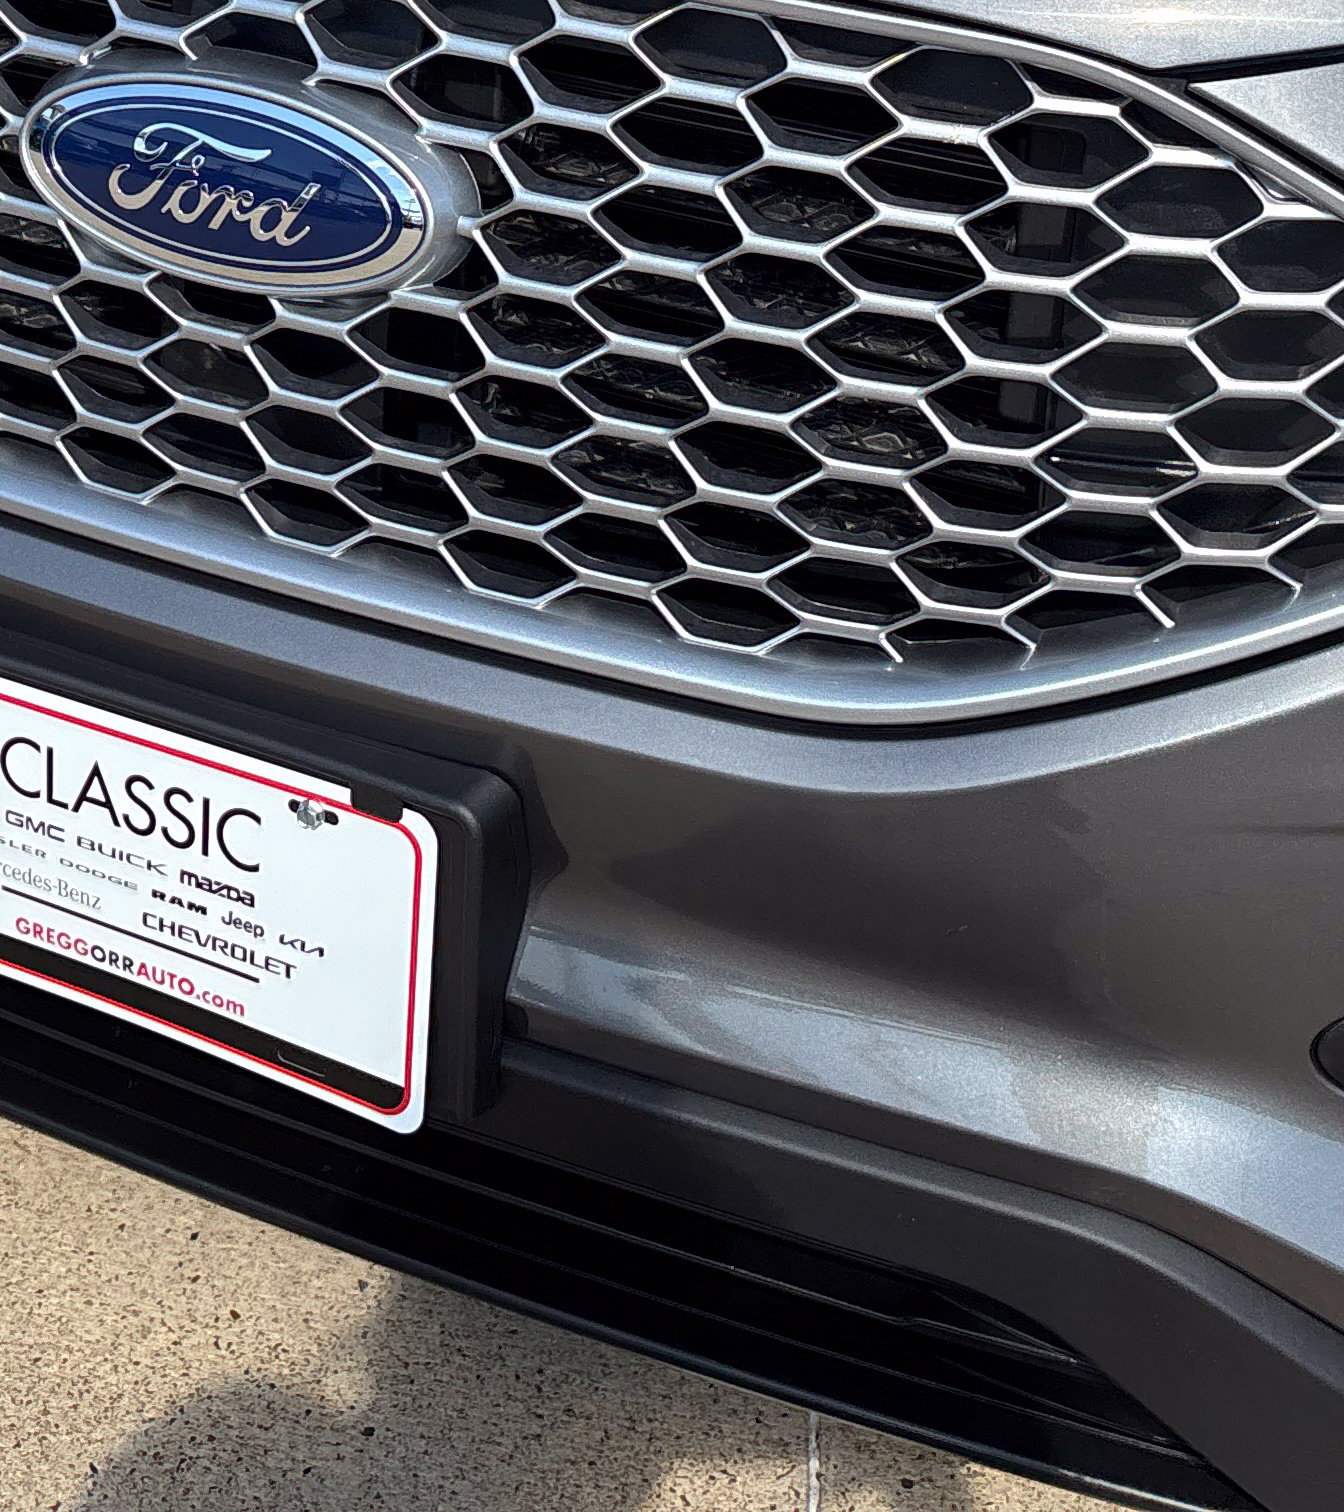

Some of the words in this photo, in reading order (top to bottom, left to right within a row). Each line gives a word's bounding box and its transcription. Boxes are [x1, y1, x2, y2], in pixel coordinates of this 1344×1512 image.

[108, 122, 322, 247] Ford
[0, 736, 260, 872] CLASSIC
[5, 809, 66, 843] GMC
[76, 836, 168, 877] BUICK
[59, 858, 138, 891] DODGE
[151, 889, 208, 916] RAM
[221, 910, 265, 938] Jeep
[15, 916, 245, 1017] GREGGORRAUTO.com
[142, 911, 298, 980] CHEVROLET
